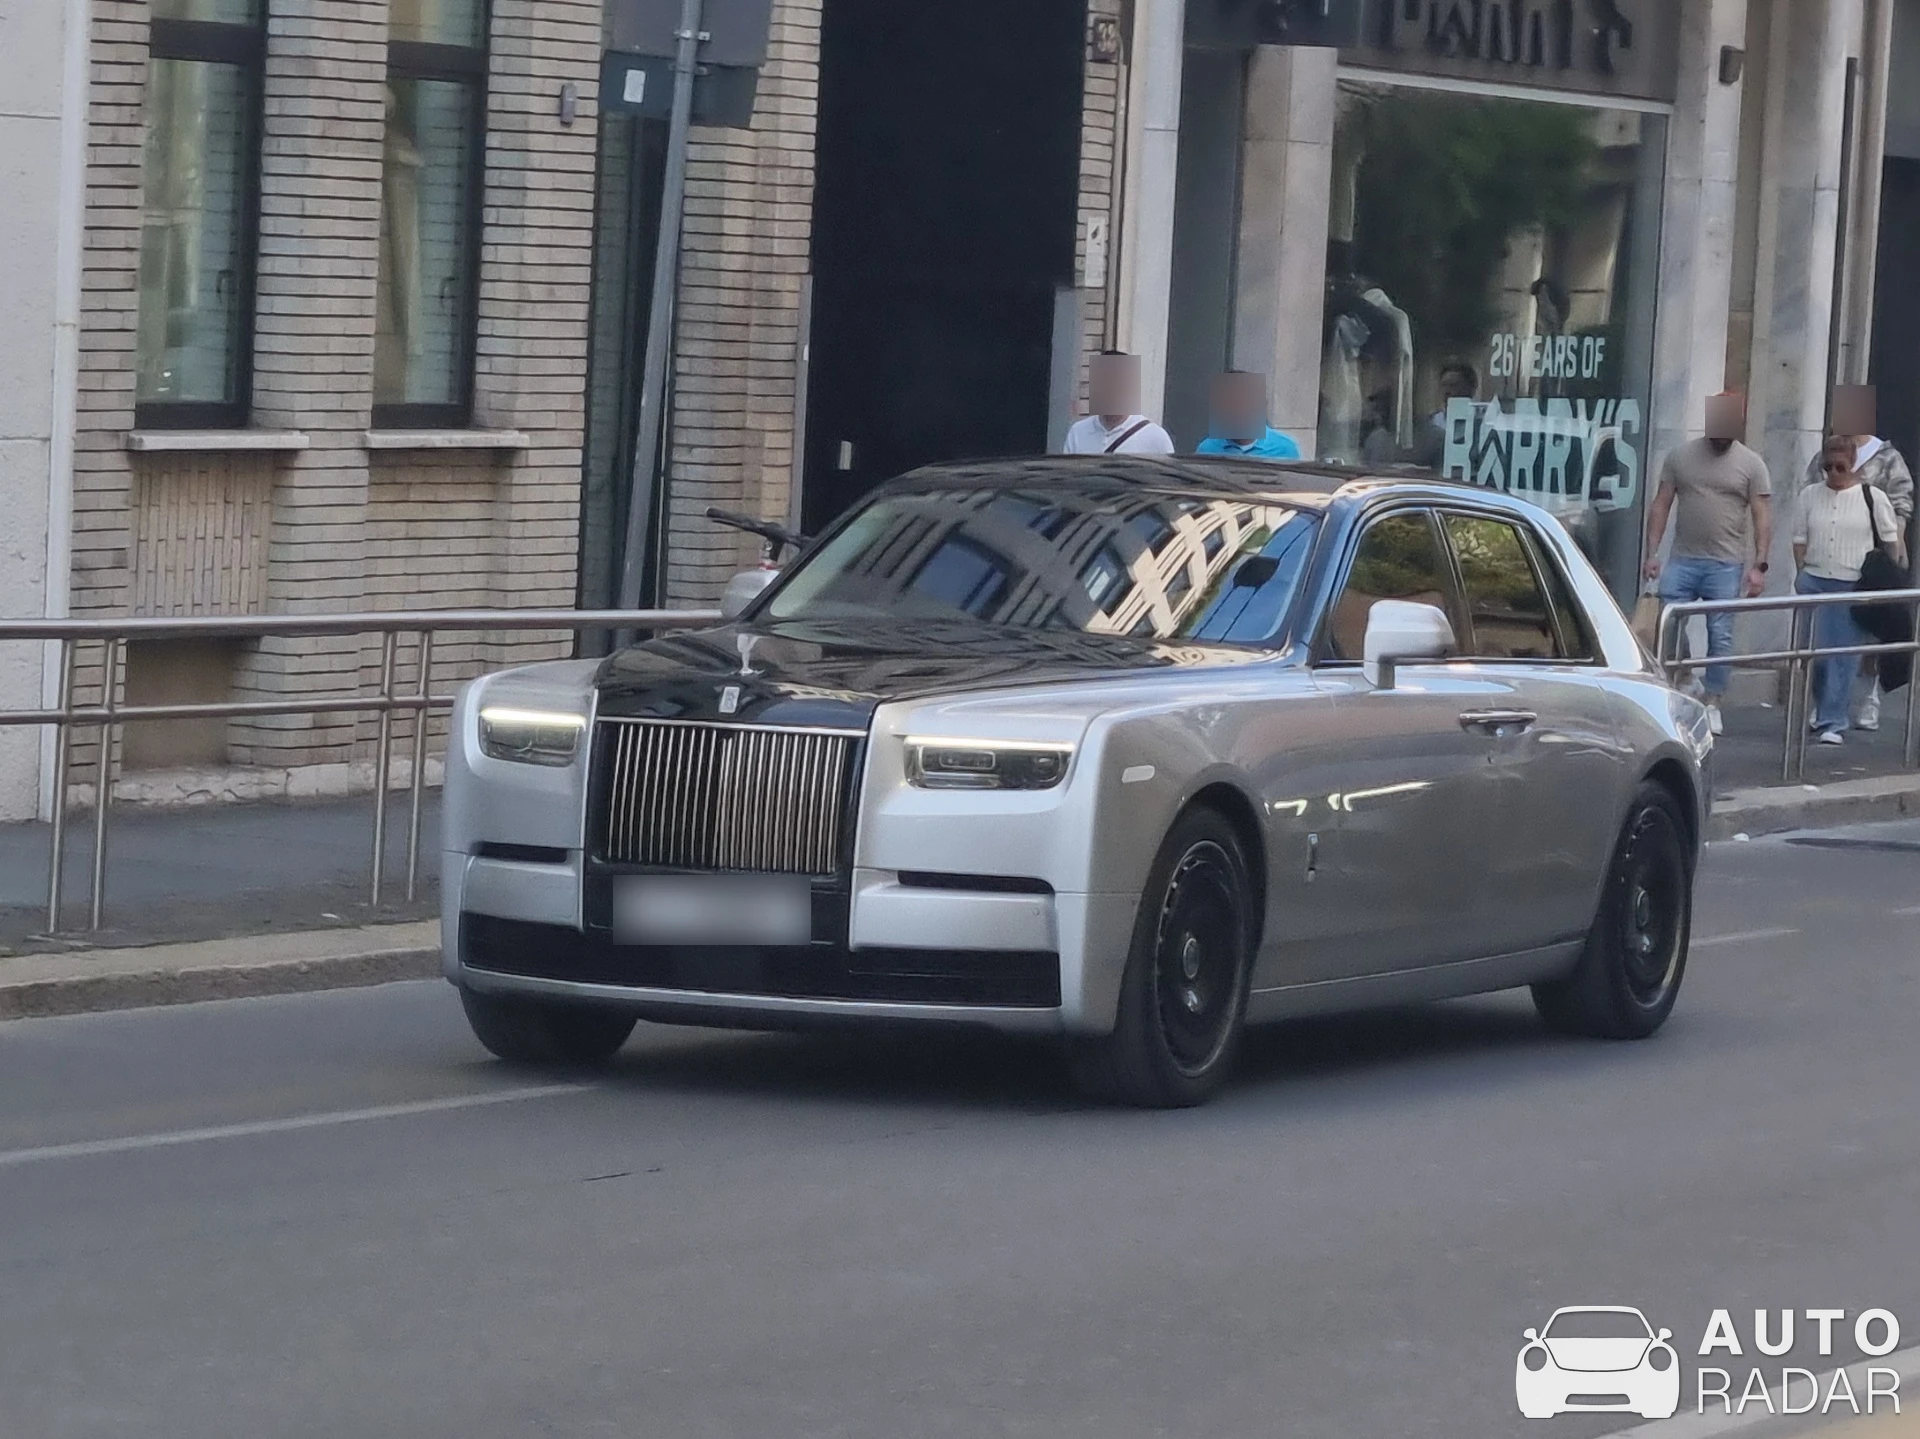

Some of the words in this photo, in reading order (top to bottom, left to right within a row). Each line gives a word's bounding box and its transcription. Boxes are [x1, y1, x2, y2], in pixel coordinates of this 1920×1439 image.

[1490, 333, 1514, 376] 26
[1582, 336, 1606, 379] OF
[1443, 396, 1641, 510] BARRY'S
